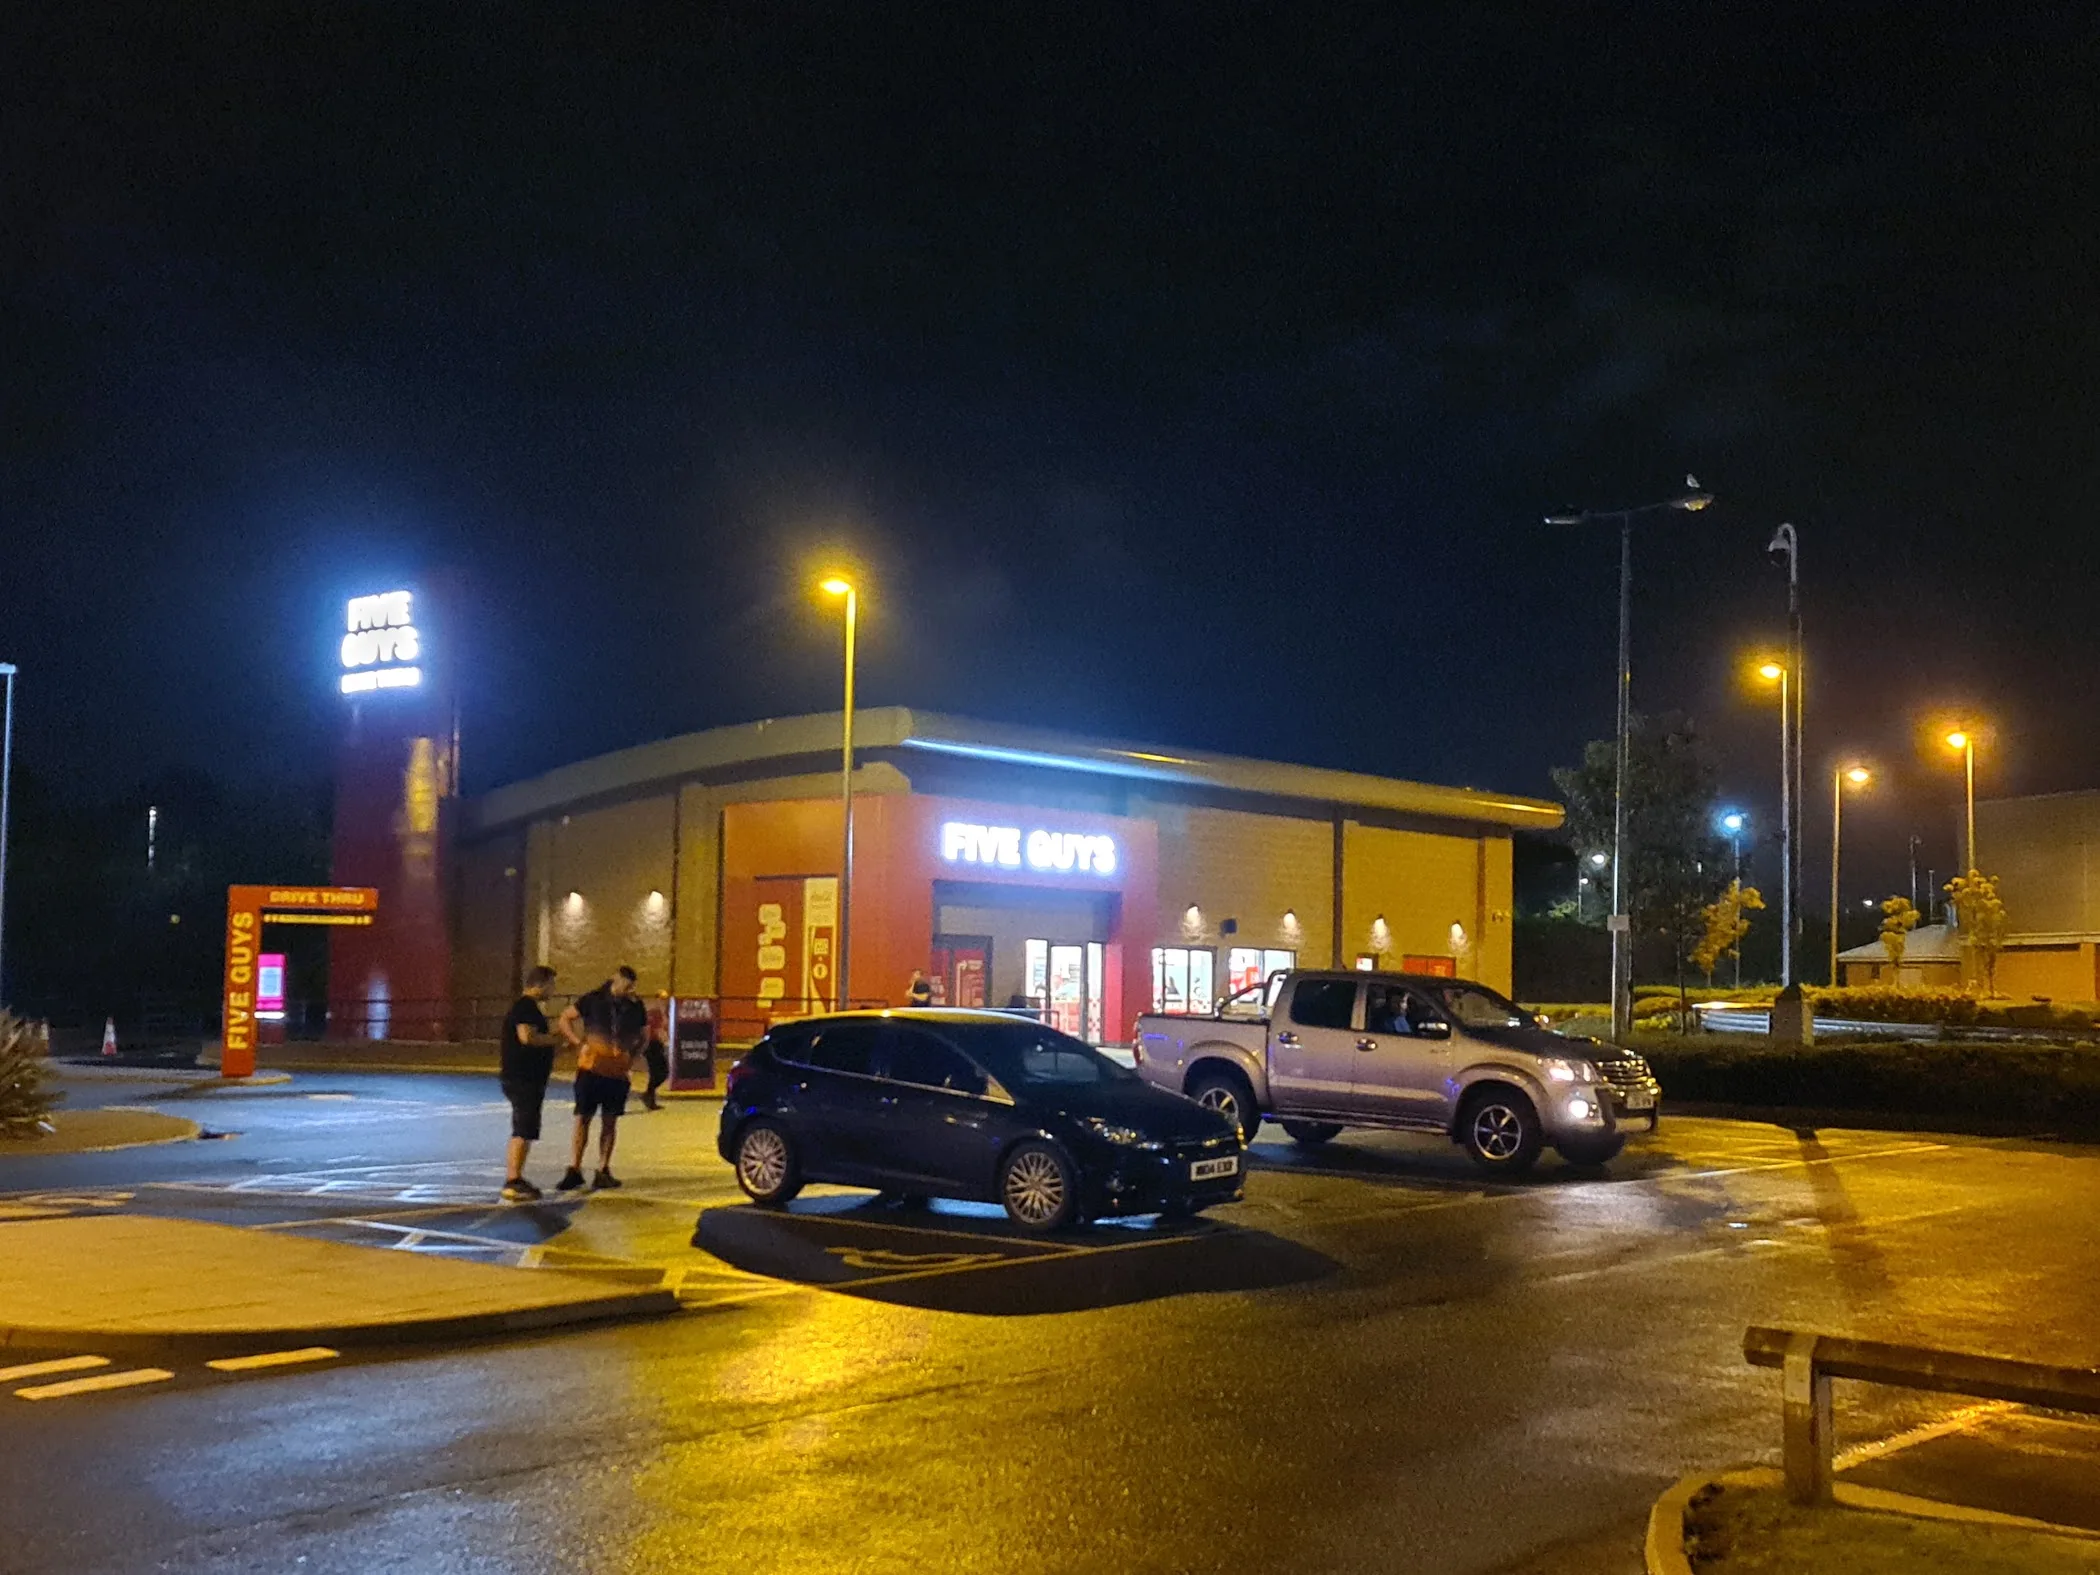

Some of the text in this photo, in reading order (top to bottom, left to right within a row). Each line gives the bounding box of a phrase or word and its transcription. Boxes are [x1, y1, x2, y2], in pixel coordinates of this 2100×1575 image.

[943, 822, 1117, 873] FIVE GUYS
[227, 911, 254, 1050] FIVE GUYS
